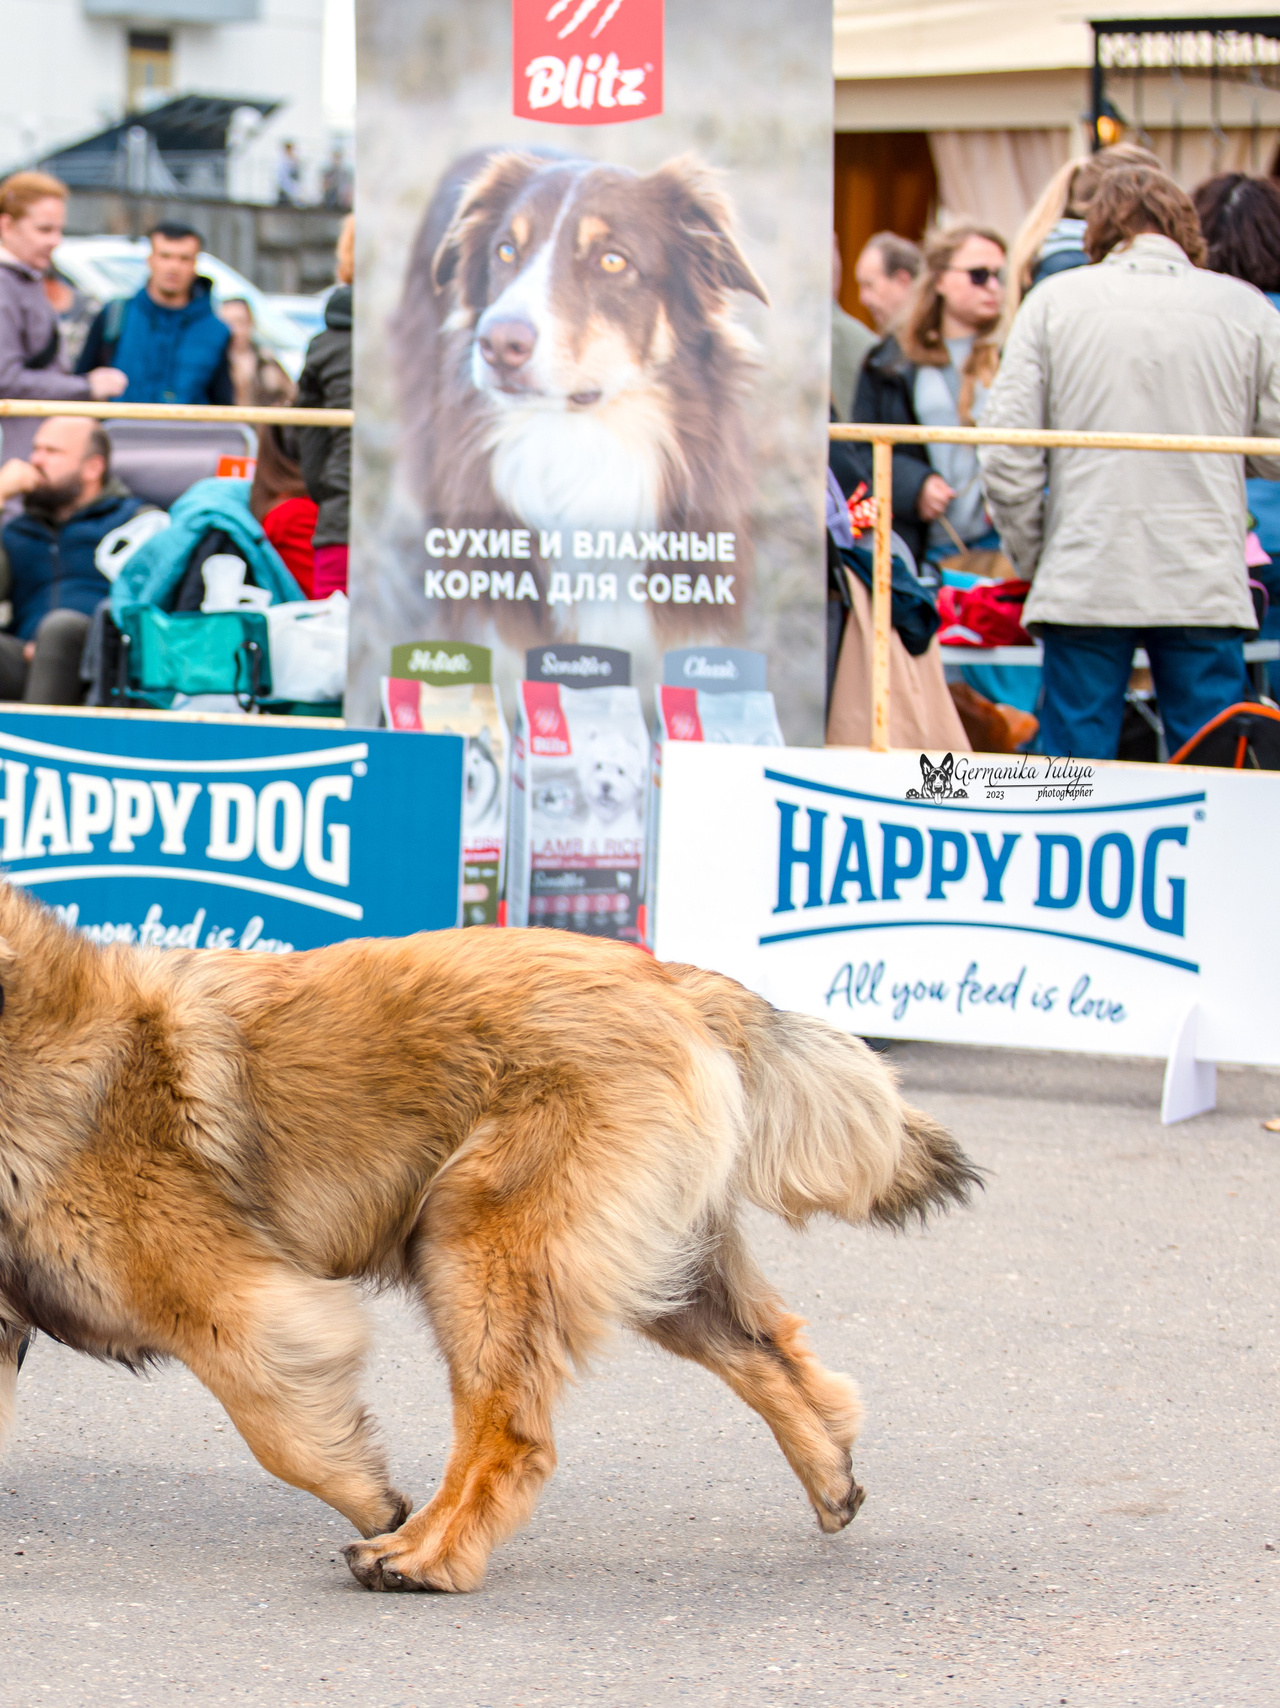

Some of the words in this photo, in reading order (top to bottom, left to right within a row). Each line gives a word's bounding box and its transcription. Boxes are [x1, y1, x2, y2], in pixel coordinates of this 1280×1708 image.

[525, 51, 647, 110] Blitz
[425, 528, 531, 559] СУХИЕ
[540, 531, 562, 559] И
[573, 531, 736, 561] ВЛАЖНЫЕ
[424, 569, 539, 600] КОРМА
[547, 573, 617, 605] ДЛЯ
[627, 574, 736, 604] СОБАК
[206, 775, 353, 887] DOG
[772, 800, 1020, 914] HAPPY
[1034, 826, 1189, 937] DOG
[825, 960, 886, 1008] All
[892, 979, 949, 1021] you
[956, 961, 1027, 1014] feed
[1031, 984, 1060, 1012] is
[1069, 974, 1127, 1024] love
